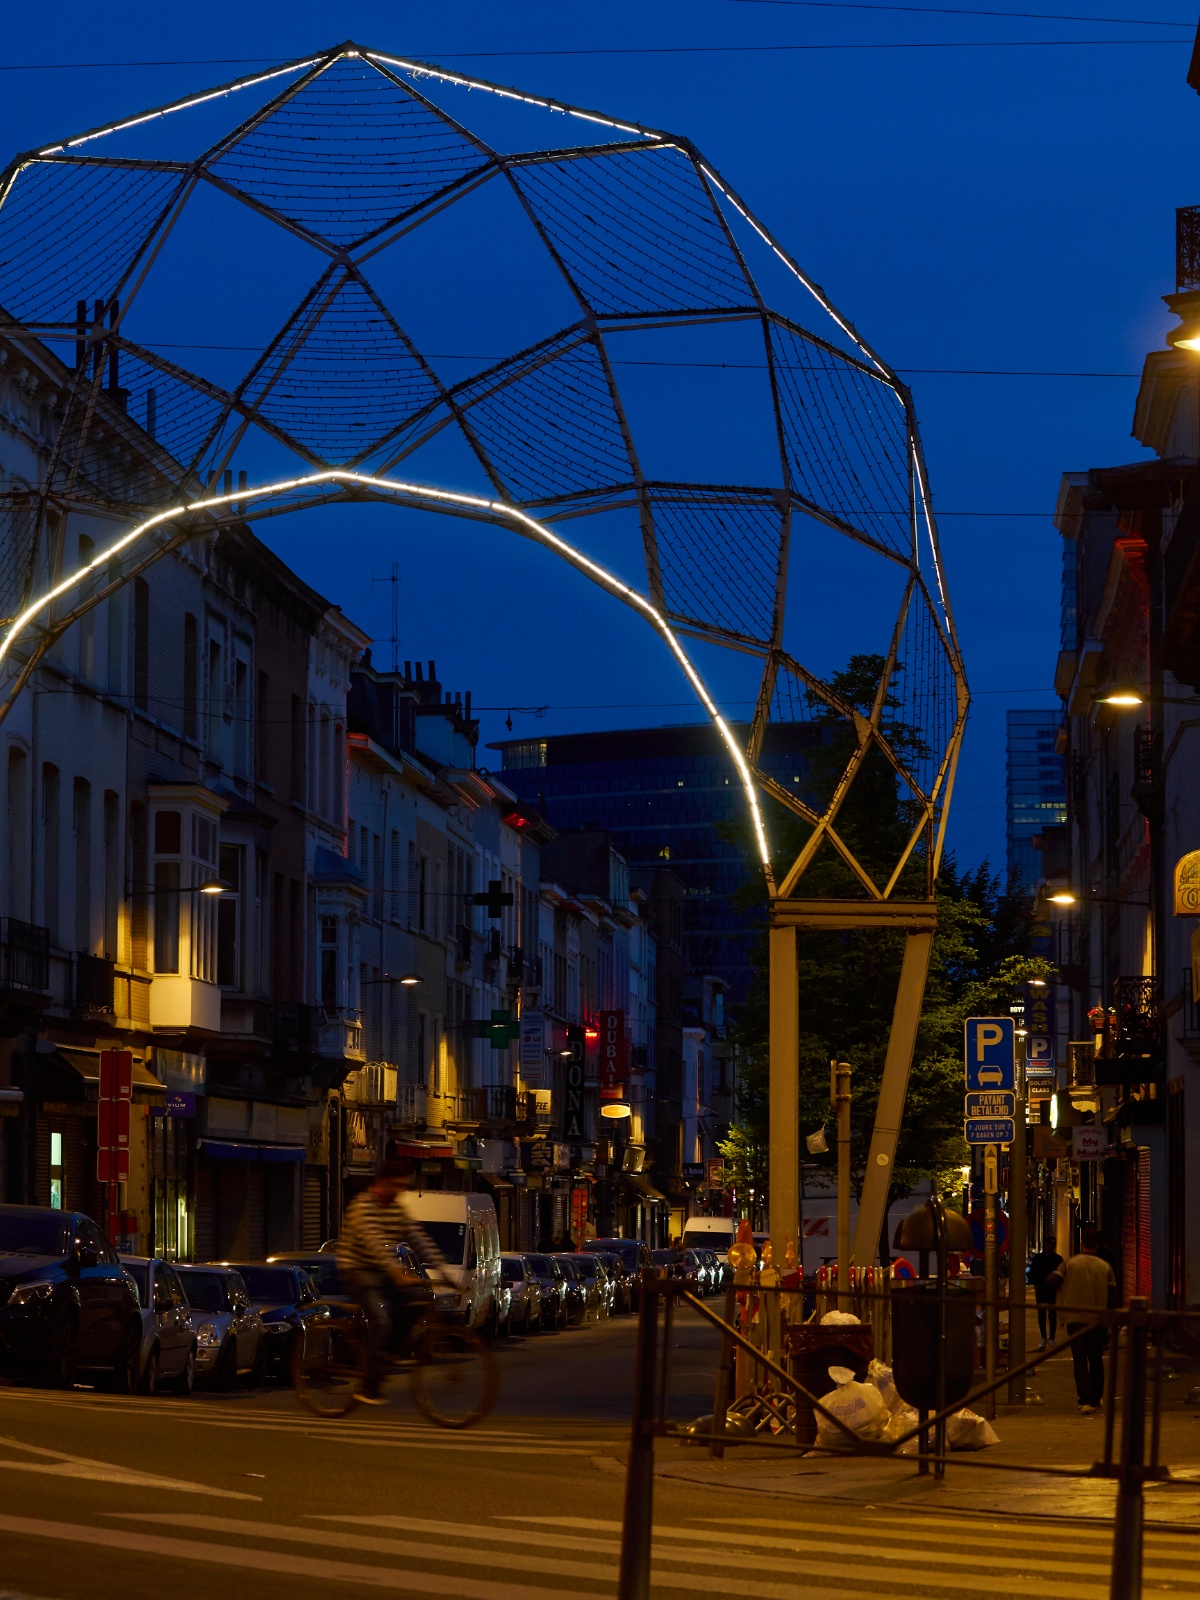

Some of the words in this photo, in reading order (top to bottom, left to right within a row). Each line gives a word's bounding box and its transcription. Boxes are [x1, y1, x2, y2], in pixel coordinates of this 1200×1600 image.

[1028, 989, 1051, 1032] WASH
[606, 1015, 618, 1088] DUBAI
[977, 1024, 1003, 1061] P
[1031, 1038, 1048, 1058] P
[566, 1040, 584, 1136] DONA
[979, 1095, 1006, 1105] PAYANT
[971, 1105, 1009, 1116] BETALEND
[1082, 1138, 1098, 1147] My
